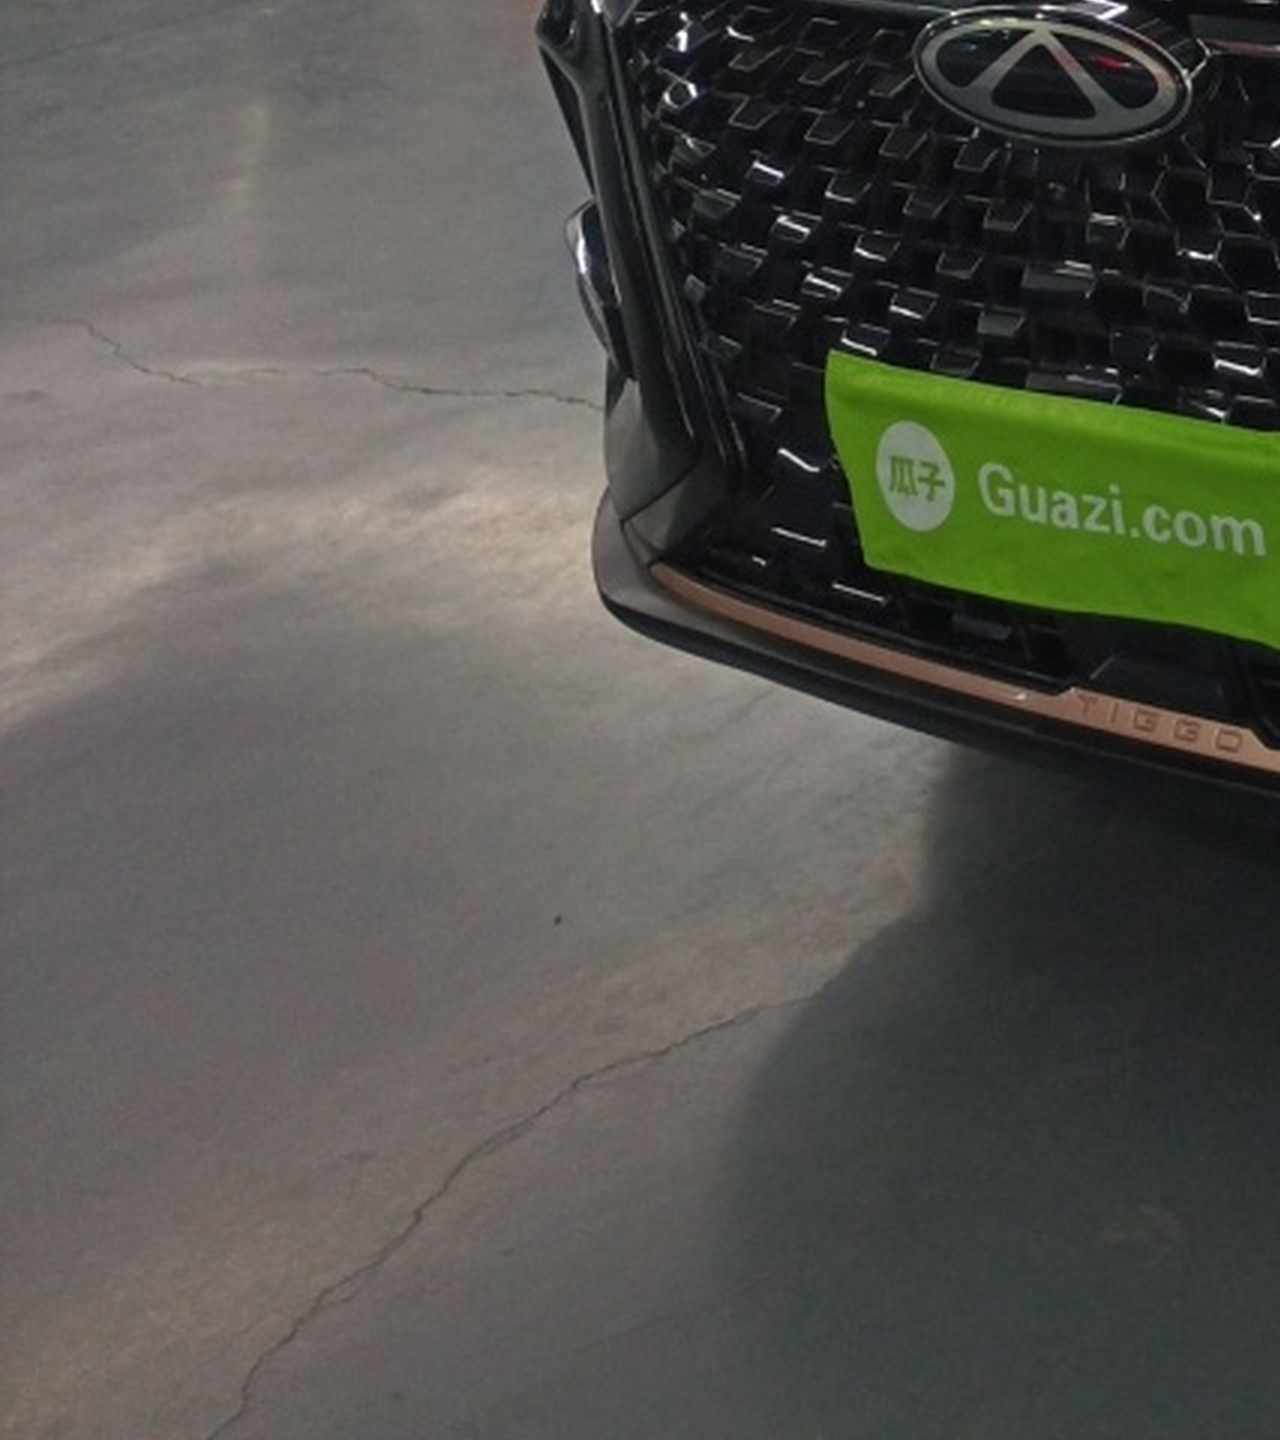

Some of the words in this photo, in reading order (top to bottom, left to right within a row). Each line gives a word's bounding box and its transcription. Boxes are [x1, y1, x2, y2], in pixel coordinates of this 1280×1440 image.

[889, 455, 946, 502] 瓜子
[977, 461, 1268, 557] Guazi.com
[1077, 694, 1243, 753] TIGGO
